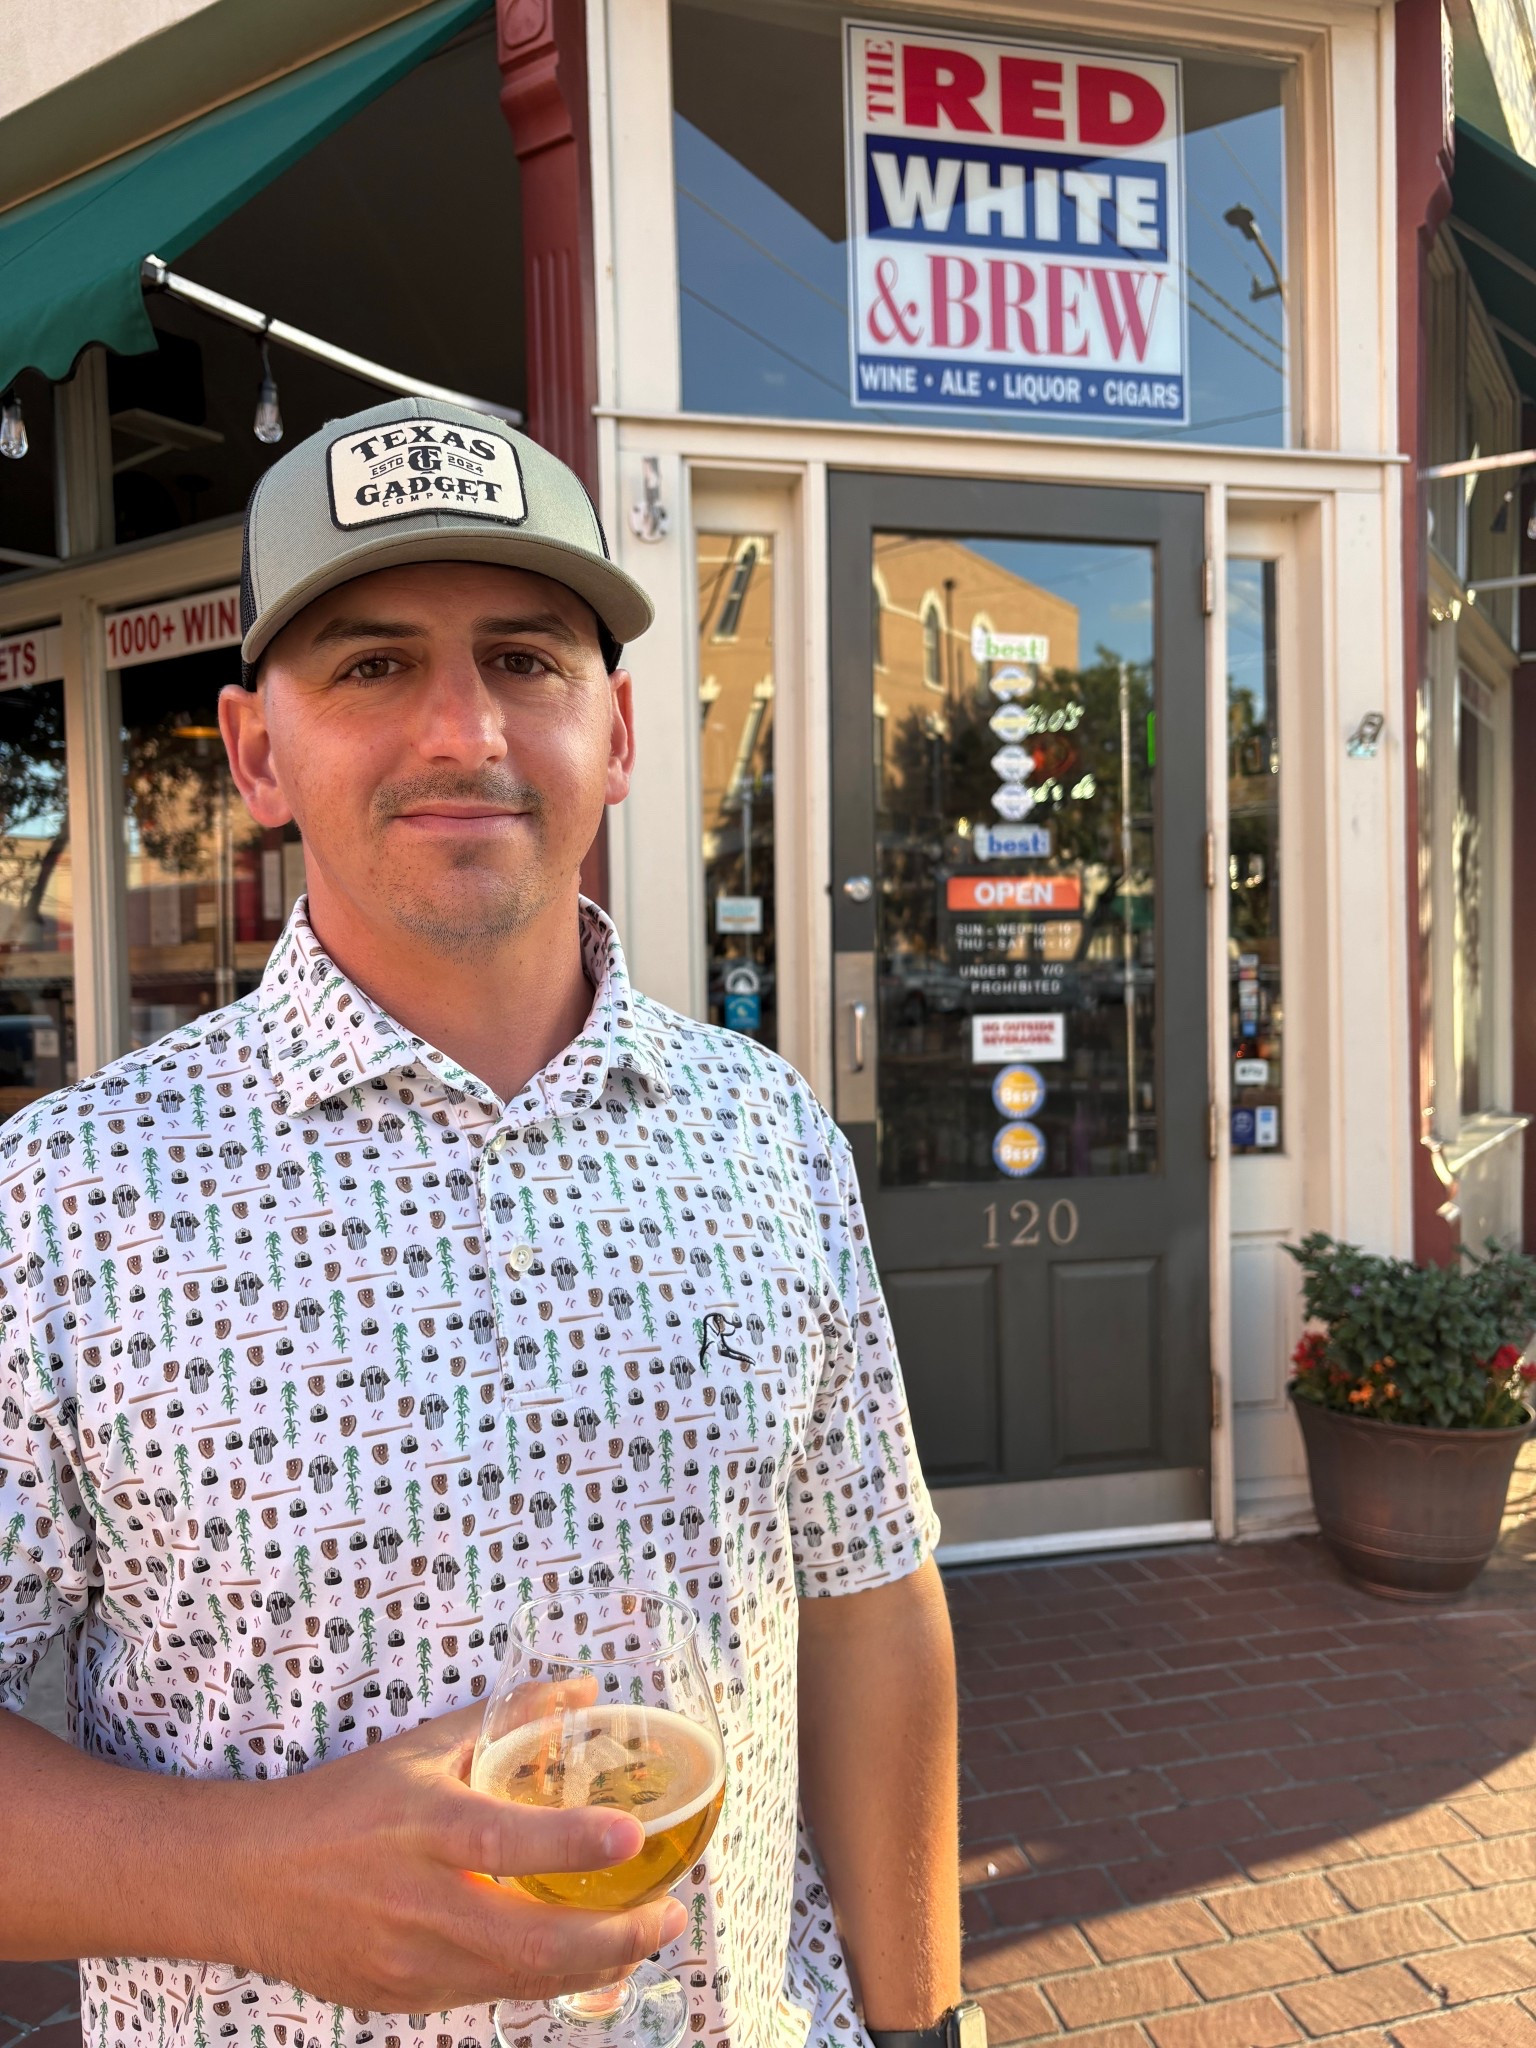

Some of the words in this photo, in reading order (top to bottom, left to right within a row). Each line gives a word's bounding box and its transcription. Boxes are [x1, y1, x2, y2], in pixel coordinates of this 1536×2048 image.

[865, 38, 895, 121] THE
[902, 44, 1166, 147] RED
[871, 152, 1160, 249] WHITE
[860, 363, 918, 393] WINE
[940, 369, 981, 397] ALE
[1004, 373, 1081, 404] LIQUOR
[1103, 381, 1180, 409] CIGARS
[350, 426, 496, 463] TEXAS
[371, 456, 404, 477] ESTD
[447, 455, 484, 474] 2024
[355, 476, 503, 506] GADGET
[382, 492, 480, 507] COMPANY
[108, 611, 176, 659] 1000+
[988, 831, 1039, 852] best
[974, 881, 1054, 906] OPEN
[960, 964, 1007, 978] UNDER
[1014, 964, 1028, 977] 21
[971, 981, 1062, 995] PROHIBITED
[983, 1198, 1079, 1249] 120
